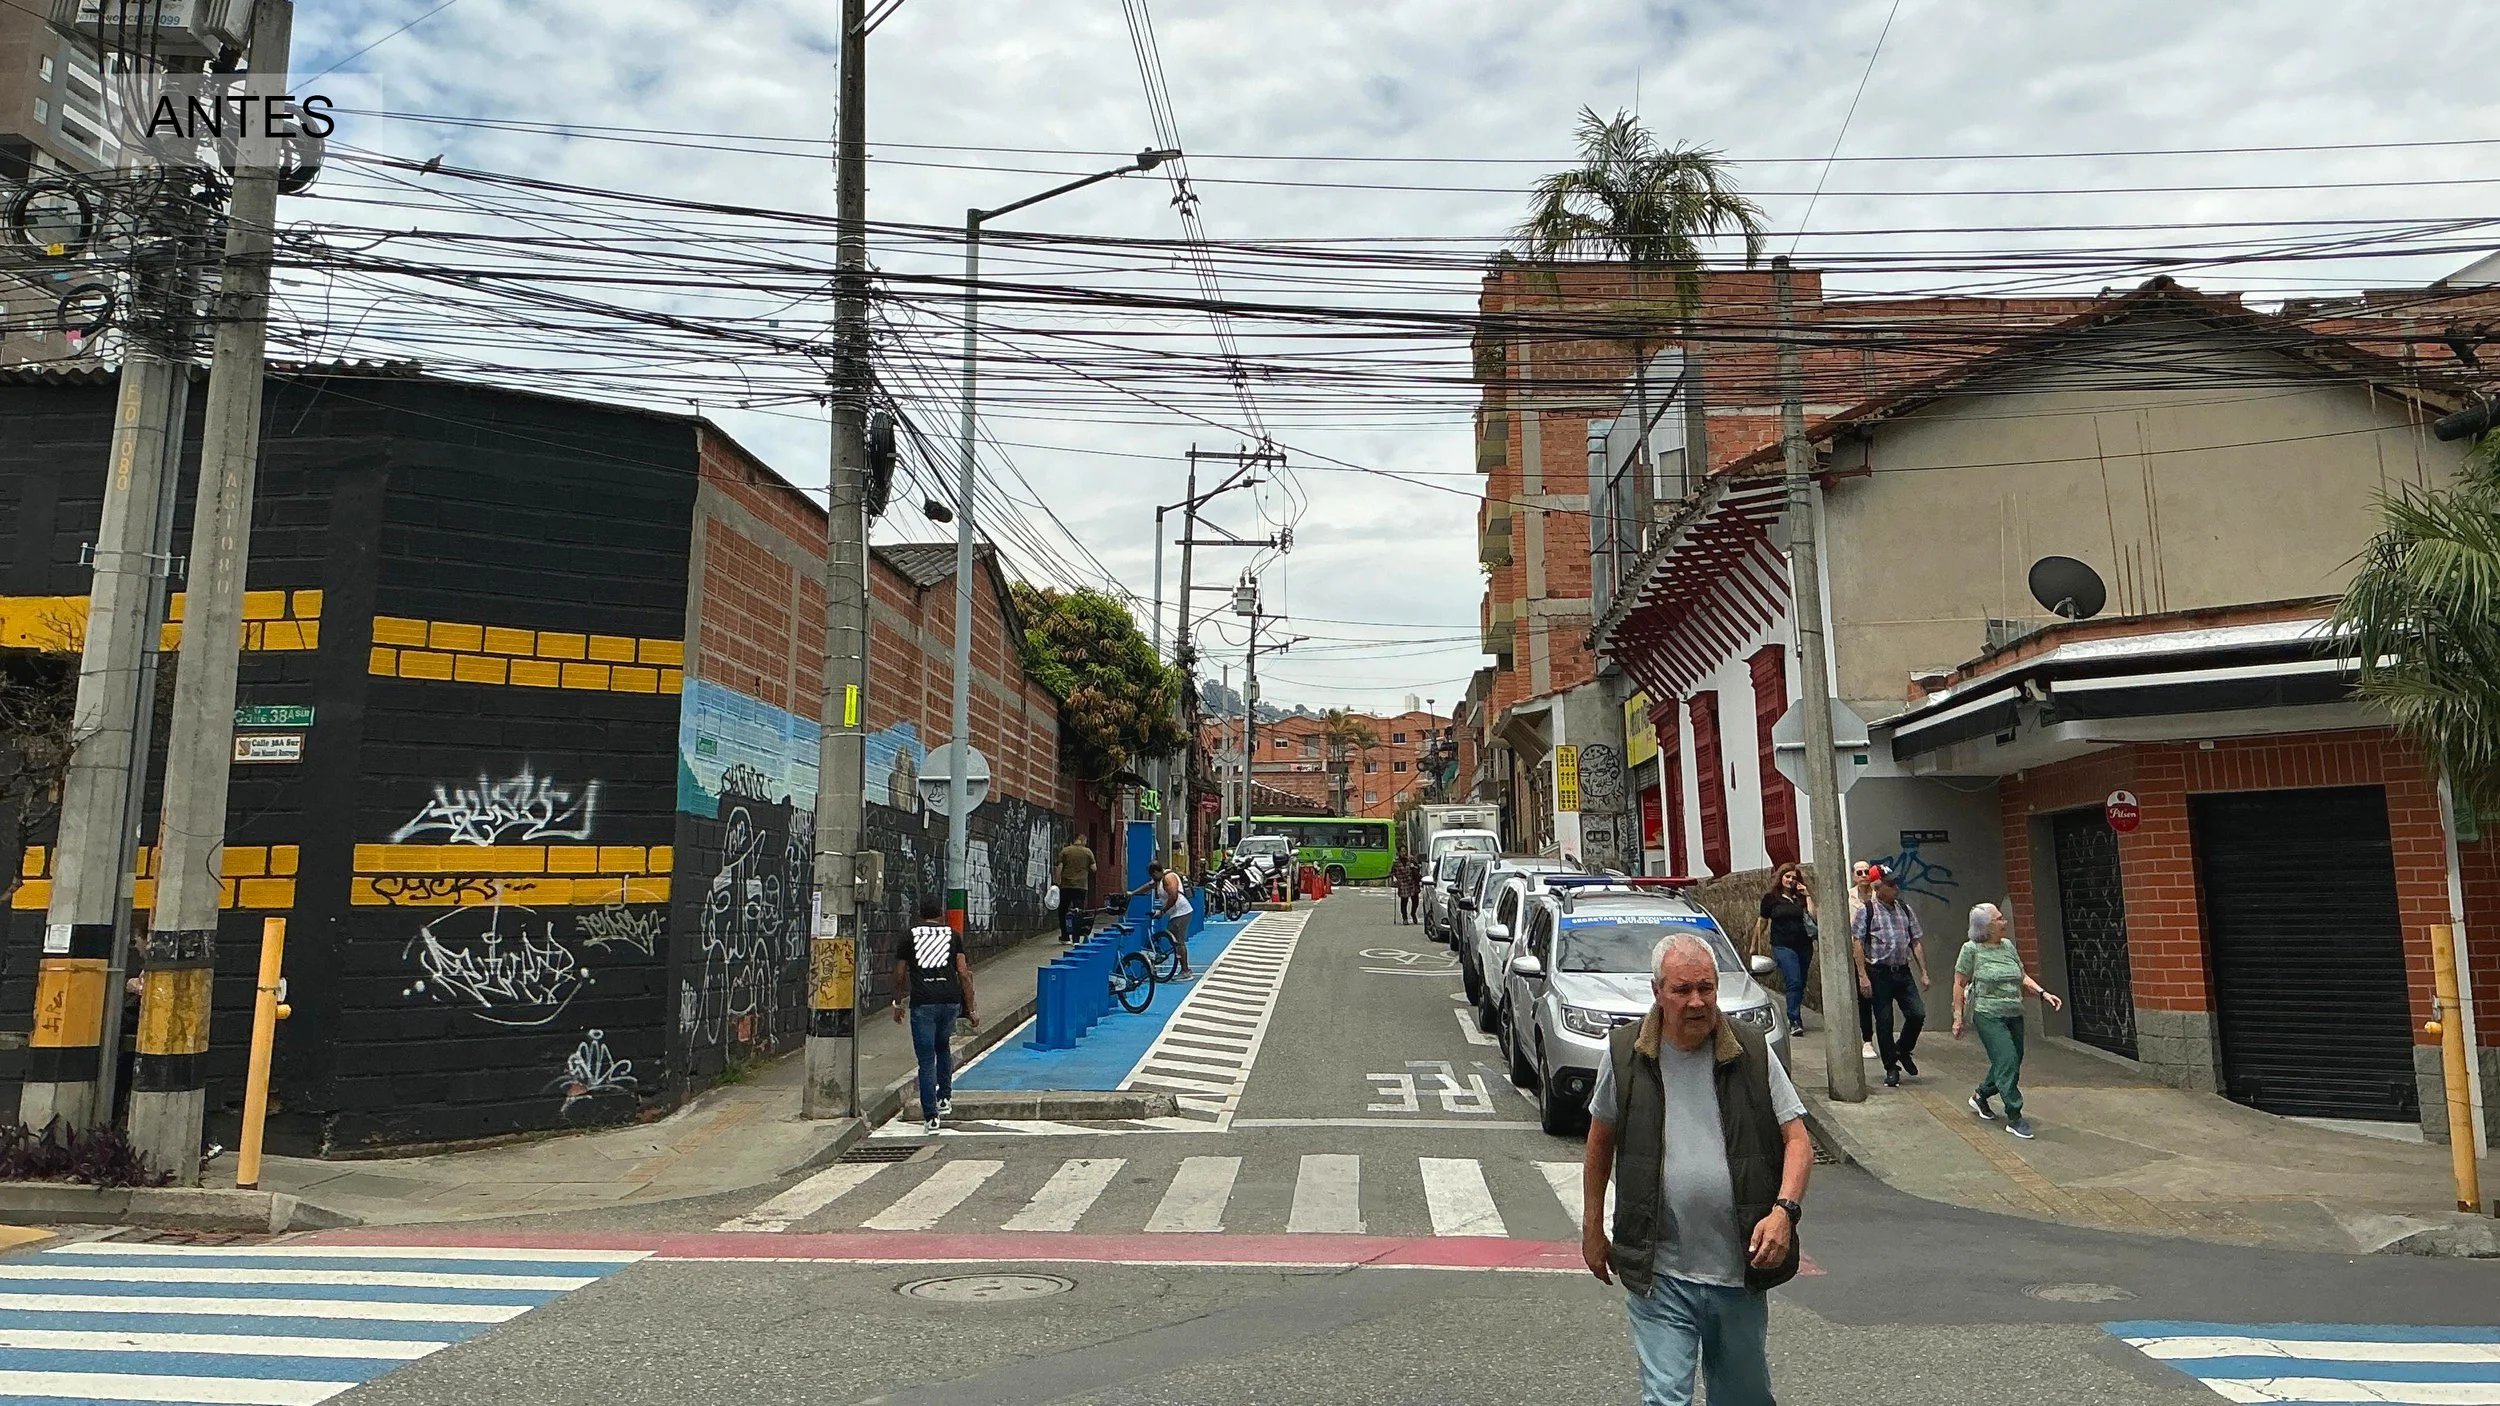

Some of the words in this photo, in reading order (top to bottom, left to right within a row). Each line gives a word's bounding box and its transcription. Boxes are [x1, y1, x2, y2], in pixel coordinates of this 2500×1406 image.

[251, 739, 270, 747] Calle
[271, 740, 285, 748] 38A
[2110, 808, 2137, 818] Pilsen
[911, 926, 952, 936] WHITE
